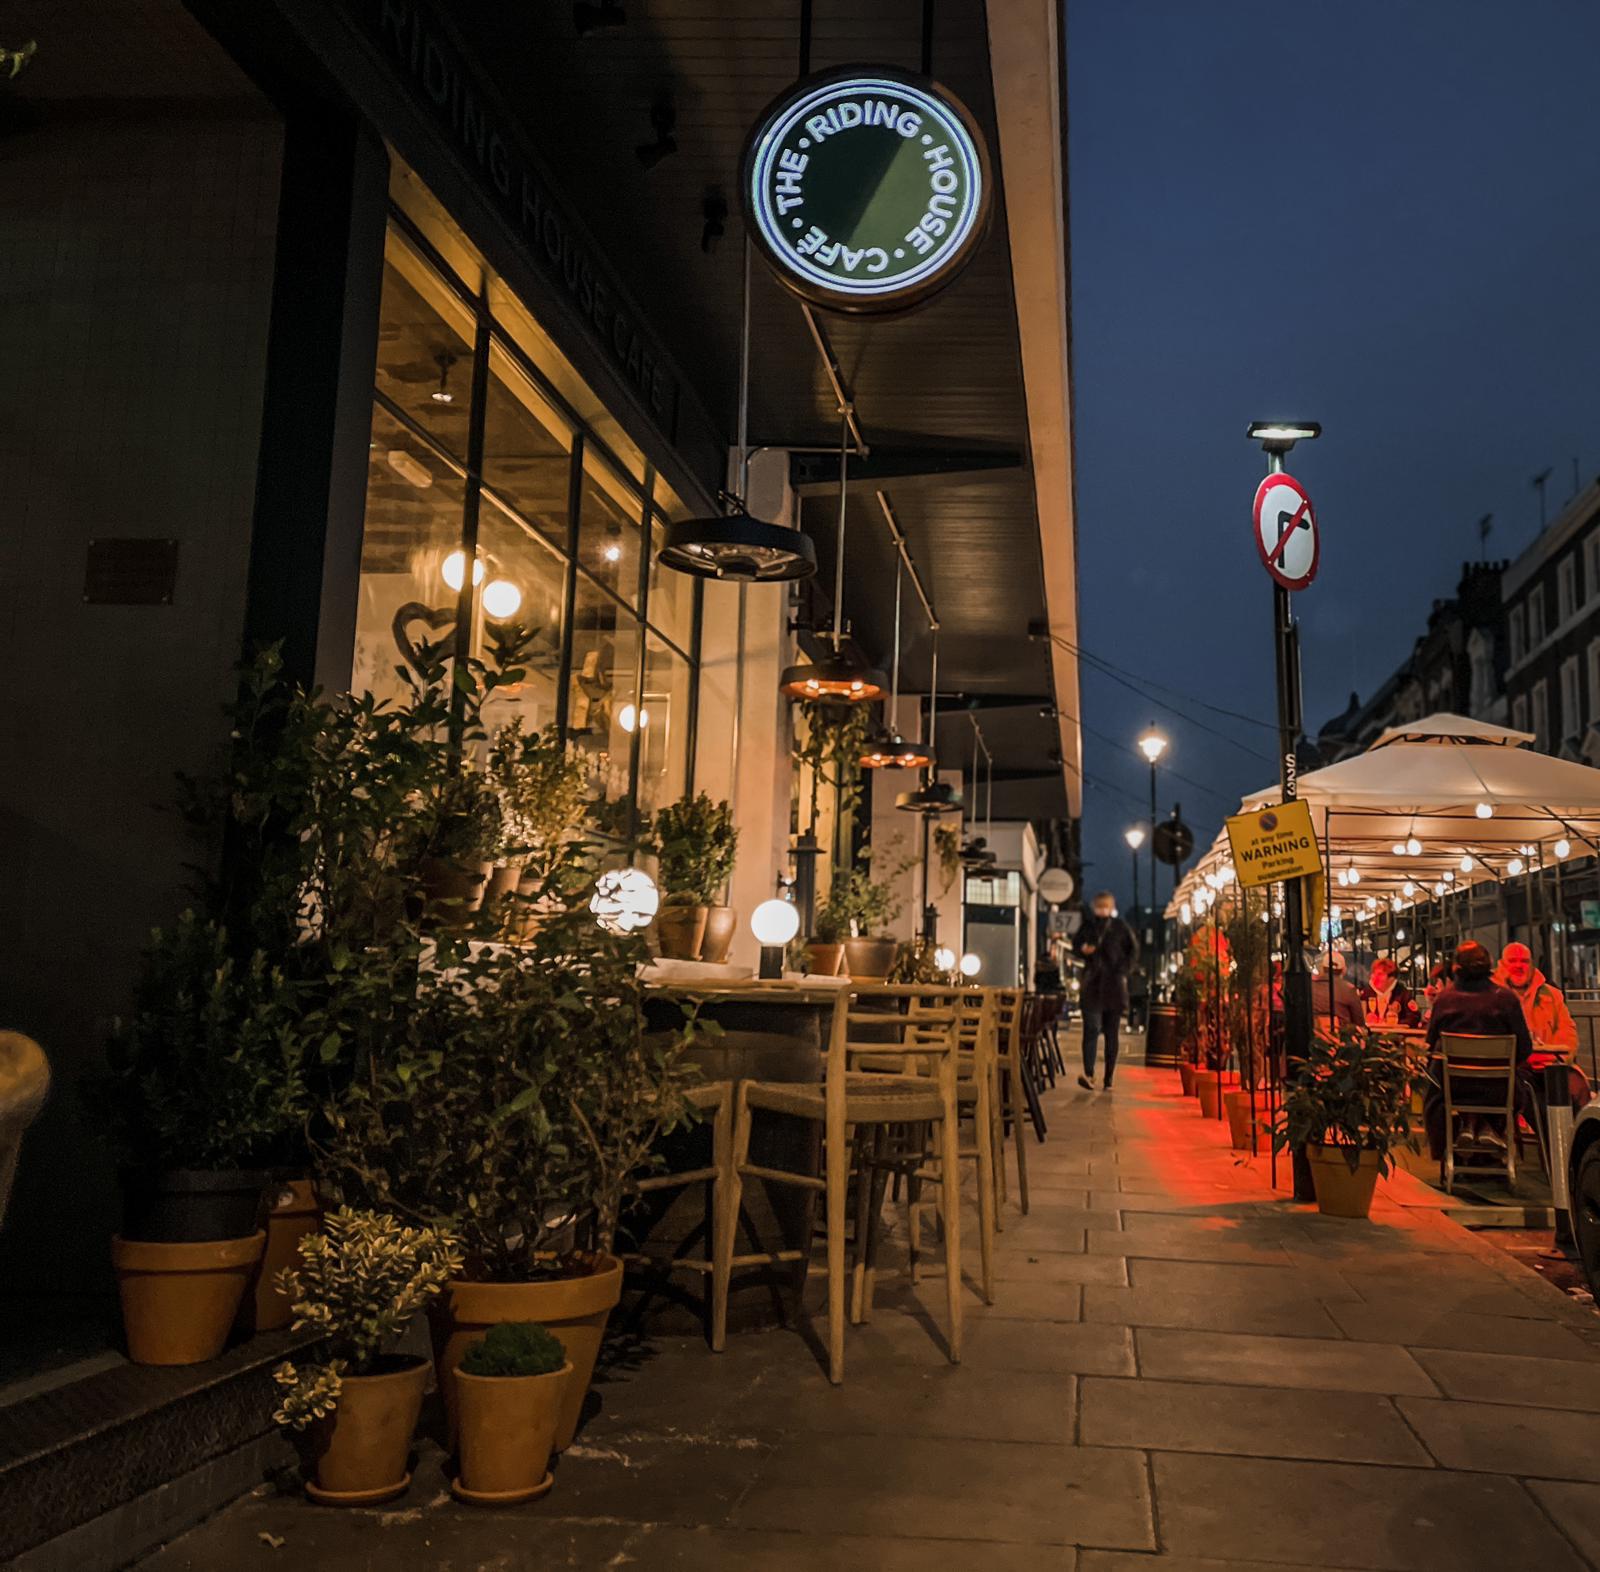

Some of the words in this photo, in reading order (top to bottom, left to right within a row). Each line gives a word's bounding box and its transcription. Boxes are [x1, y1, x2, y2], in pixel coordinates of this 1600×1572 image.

[775, 148, 809, 216] THE
[805, 99, 923, 143] RIDING
[904, 144, 958, 255] HOUSE
[1285, 753, 1296, 796] S23
[1240, 836, 1310, 862] WARNING
[1262, 857, 1294, 870] Parking
[1055, 915, 1072, 929] 57
